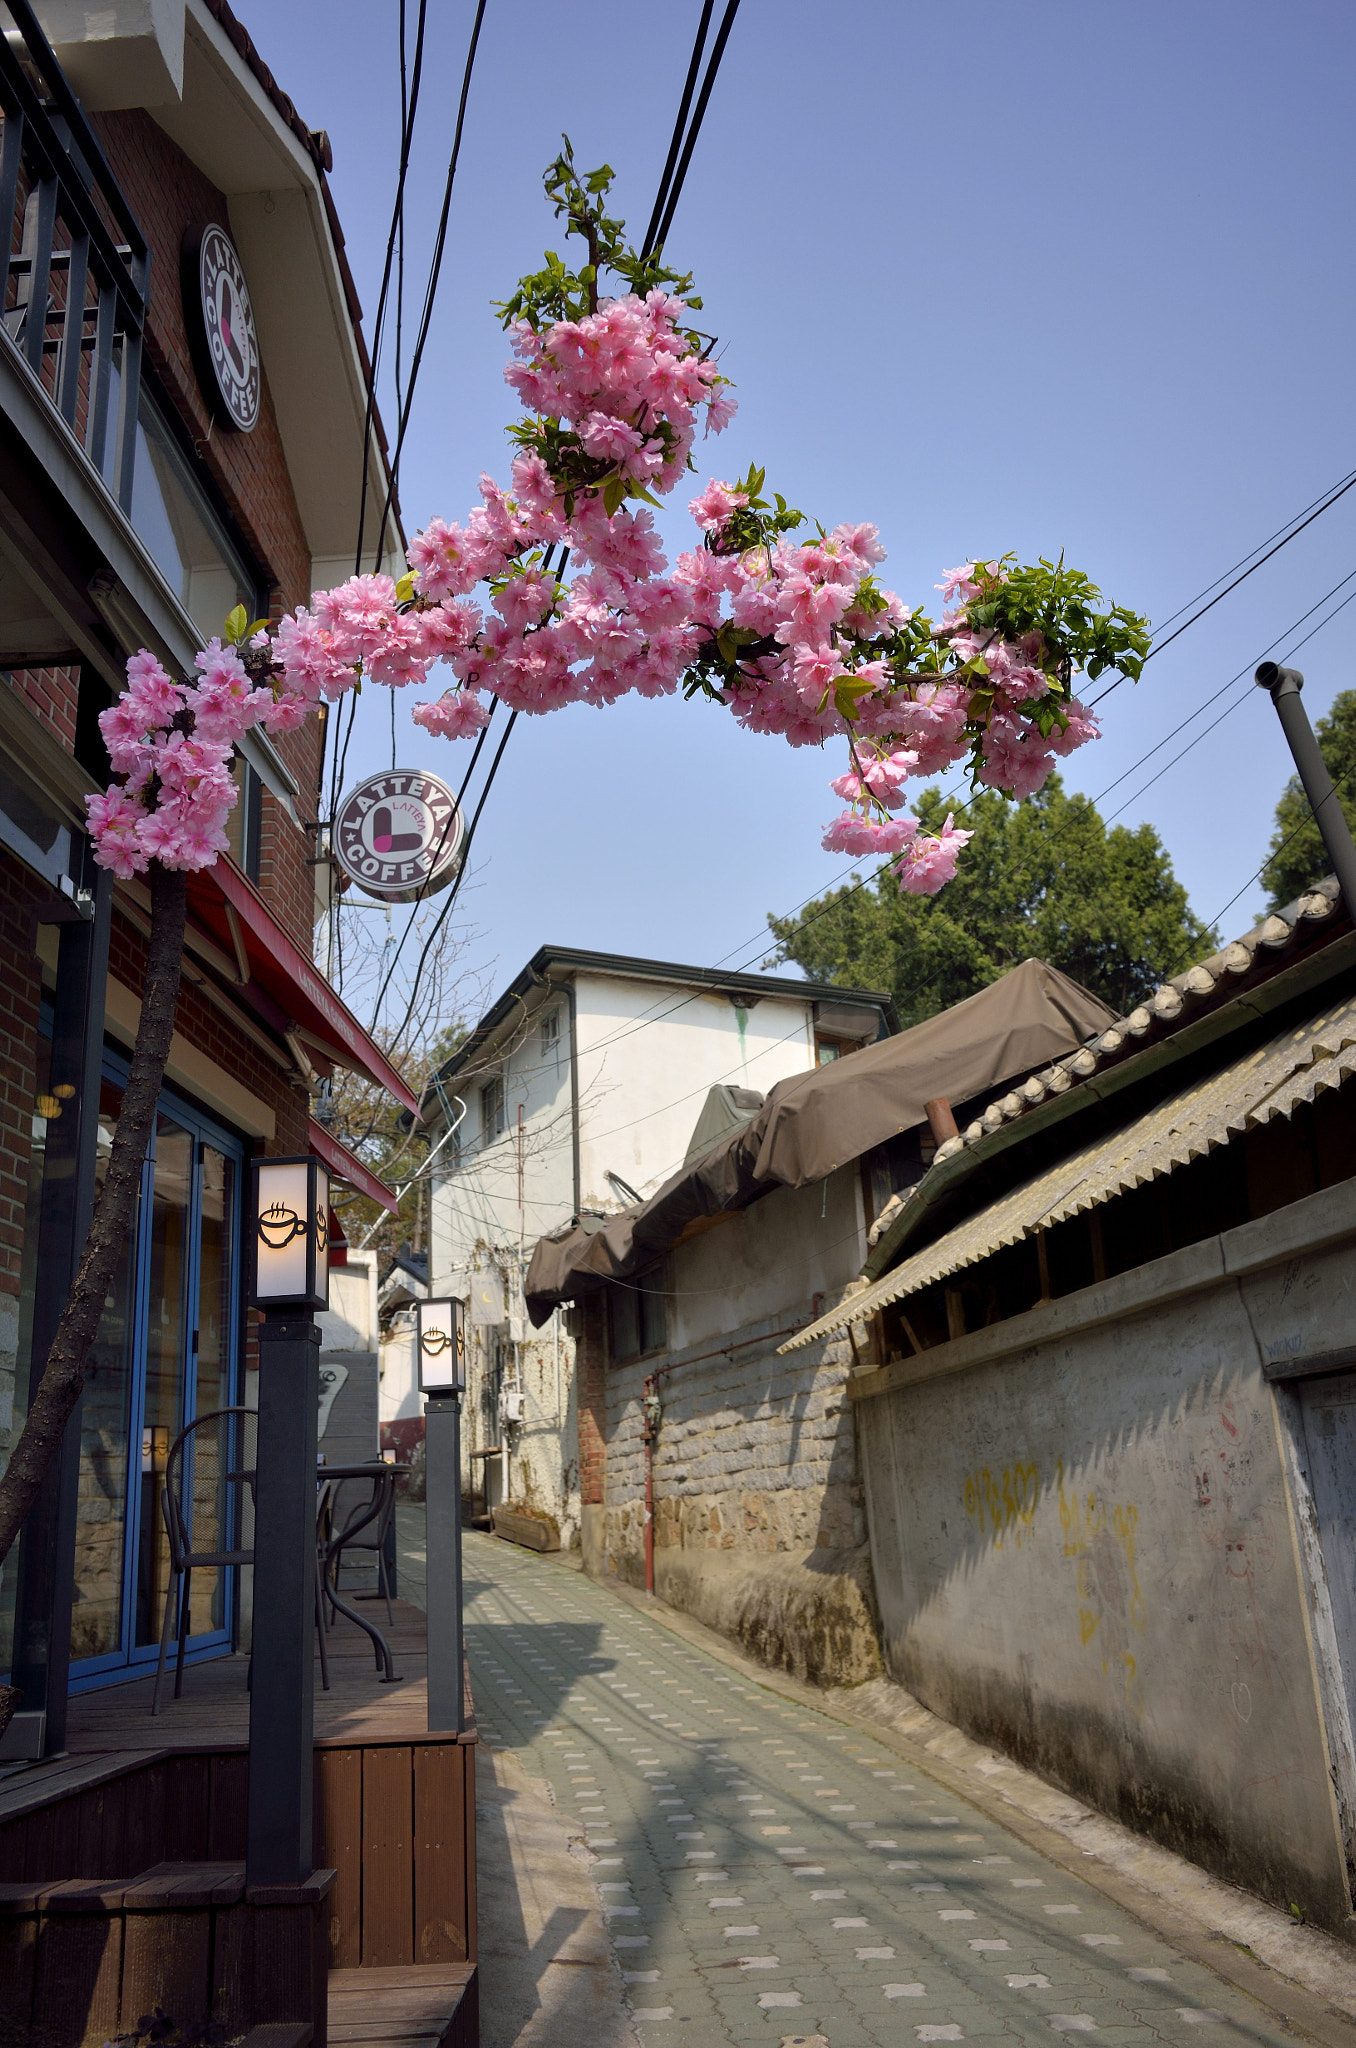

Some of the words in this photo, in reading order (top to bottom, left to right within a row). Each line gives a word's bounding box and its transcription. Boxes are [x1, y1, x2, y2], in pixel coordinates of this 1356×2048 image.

[206, 239, 257, 368] LATTEYA
[206, 296, 254, 418] COFFEE
[343, 777, 451, 830] LATTEYA
[392, 801, 427, 832] LATTEYA
[346, 837, 451, 881] COFFEE
